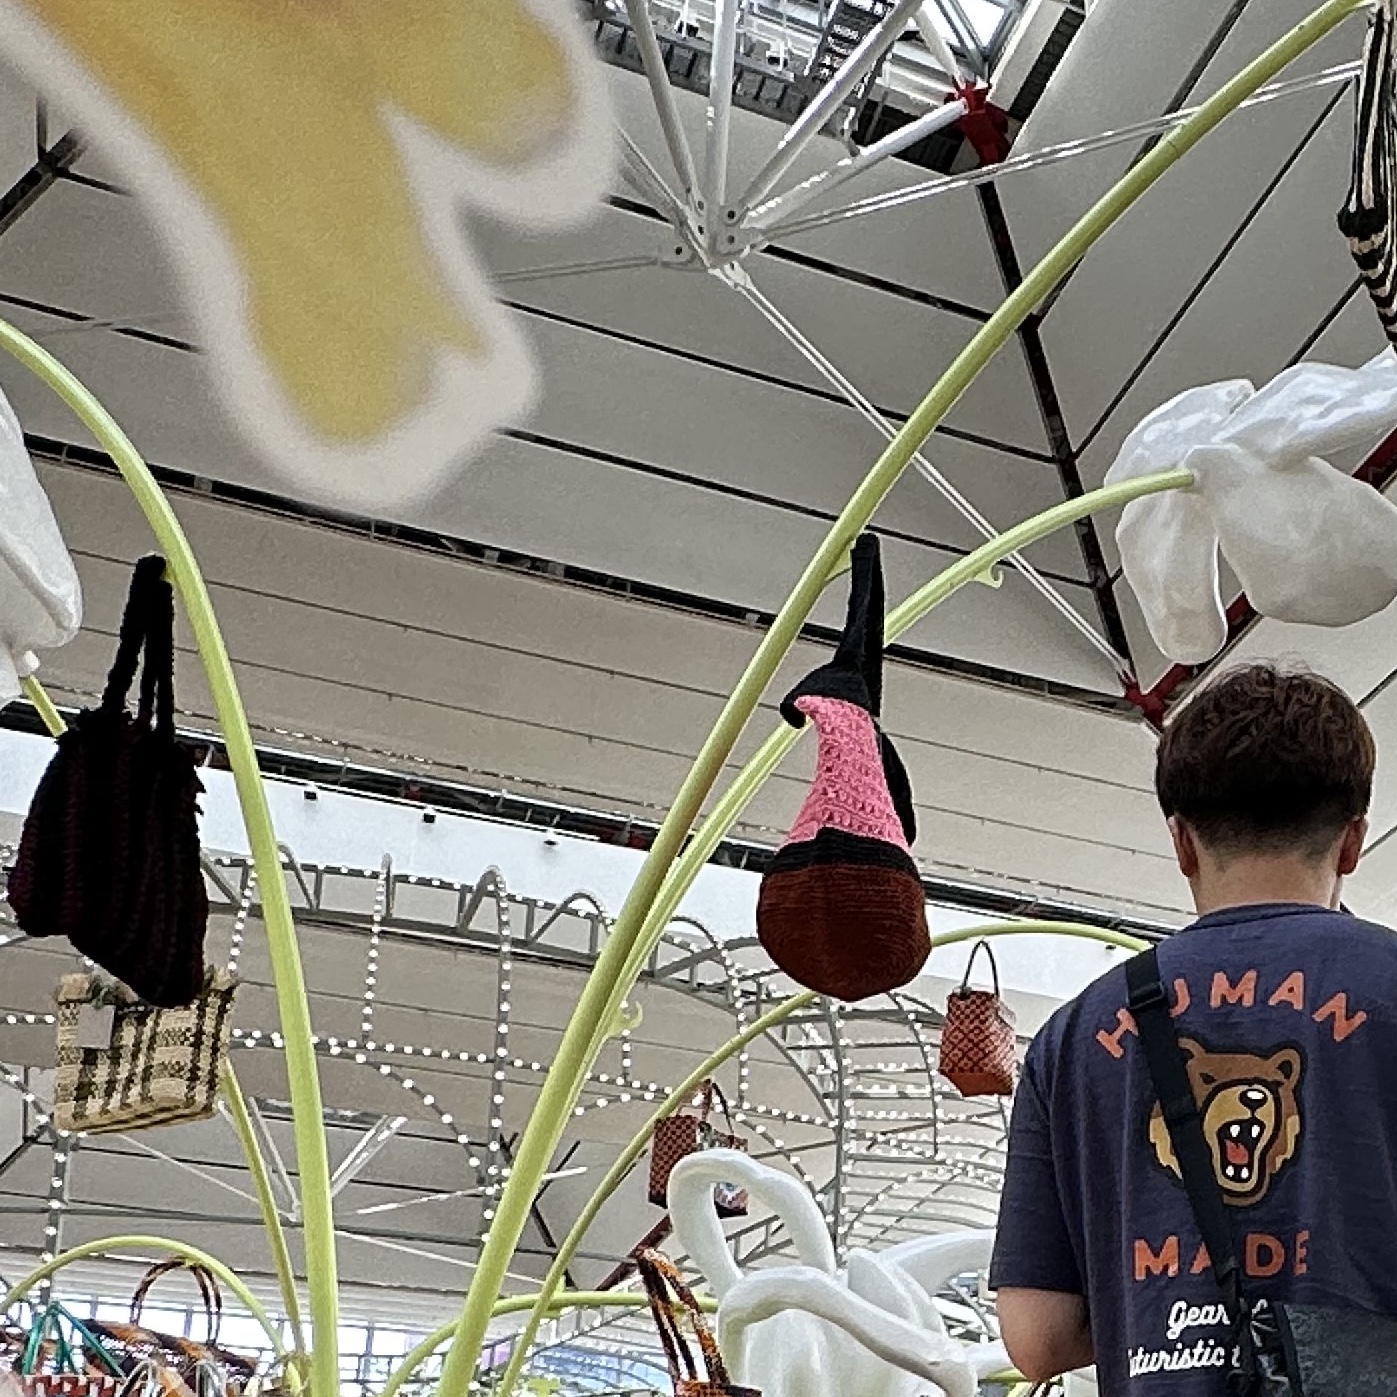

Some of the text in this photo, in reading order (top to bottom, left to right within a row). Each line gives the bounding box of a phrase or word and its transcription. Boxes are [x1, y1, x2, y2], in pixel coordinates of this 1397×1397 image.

[1095, 969, 1368, 1059] HUMAN
[1165, 1299, 1231, 1340] Gear
[1127, 1338, 1226, 1378] uturistic
